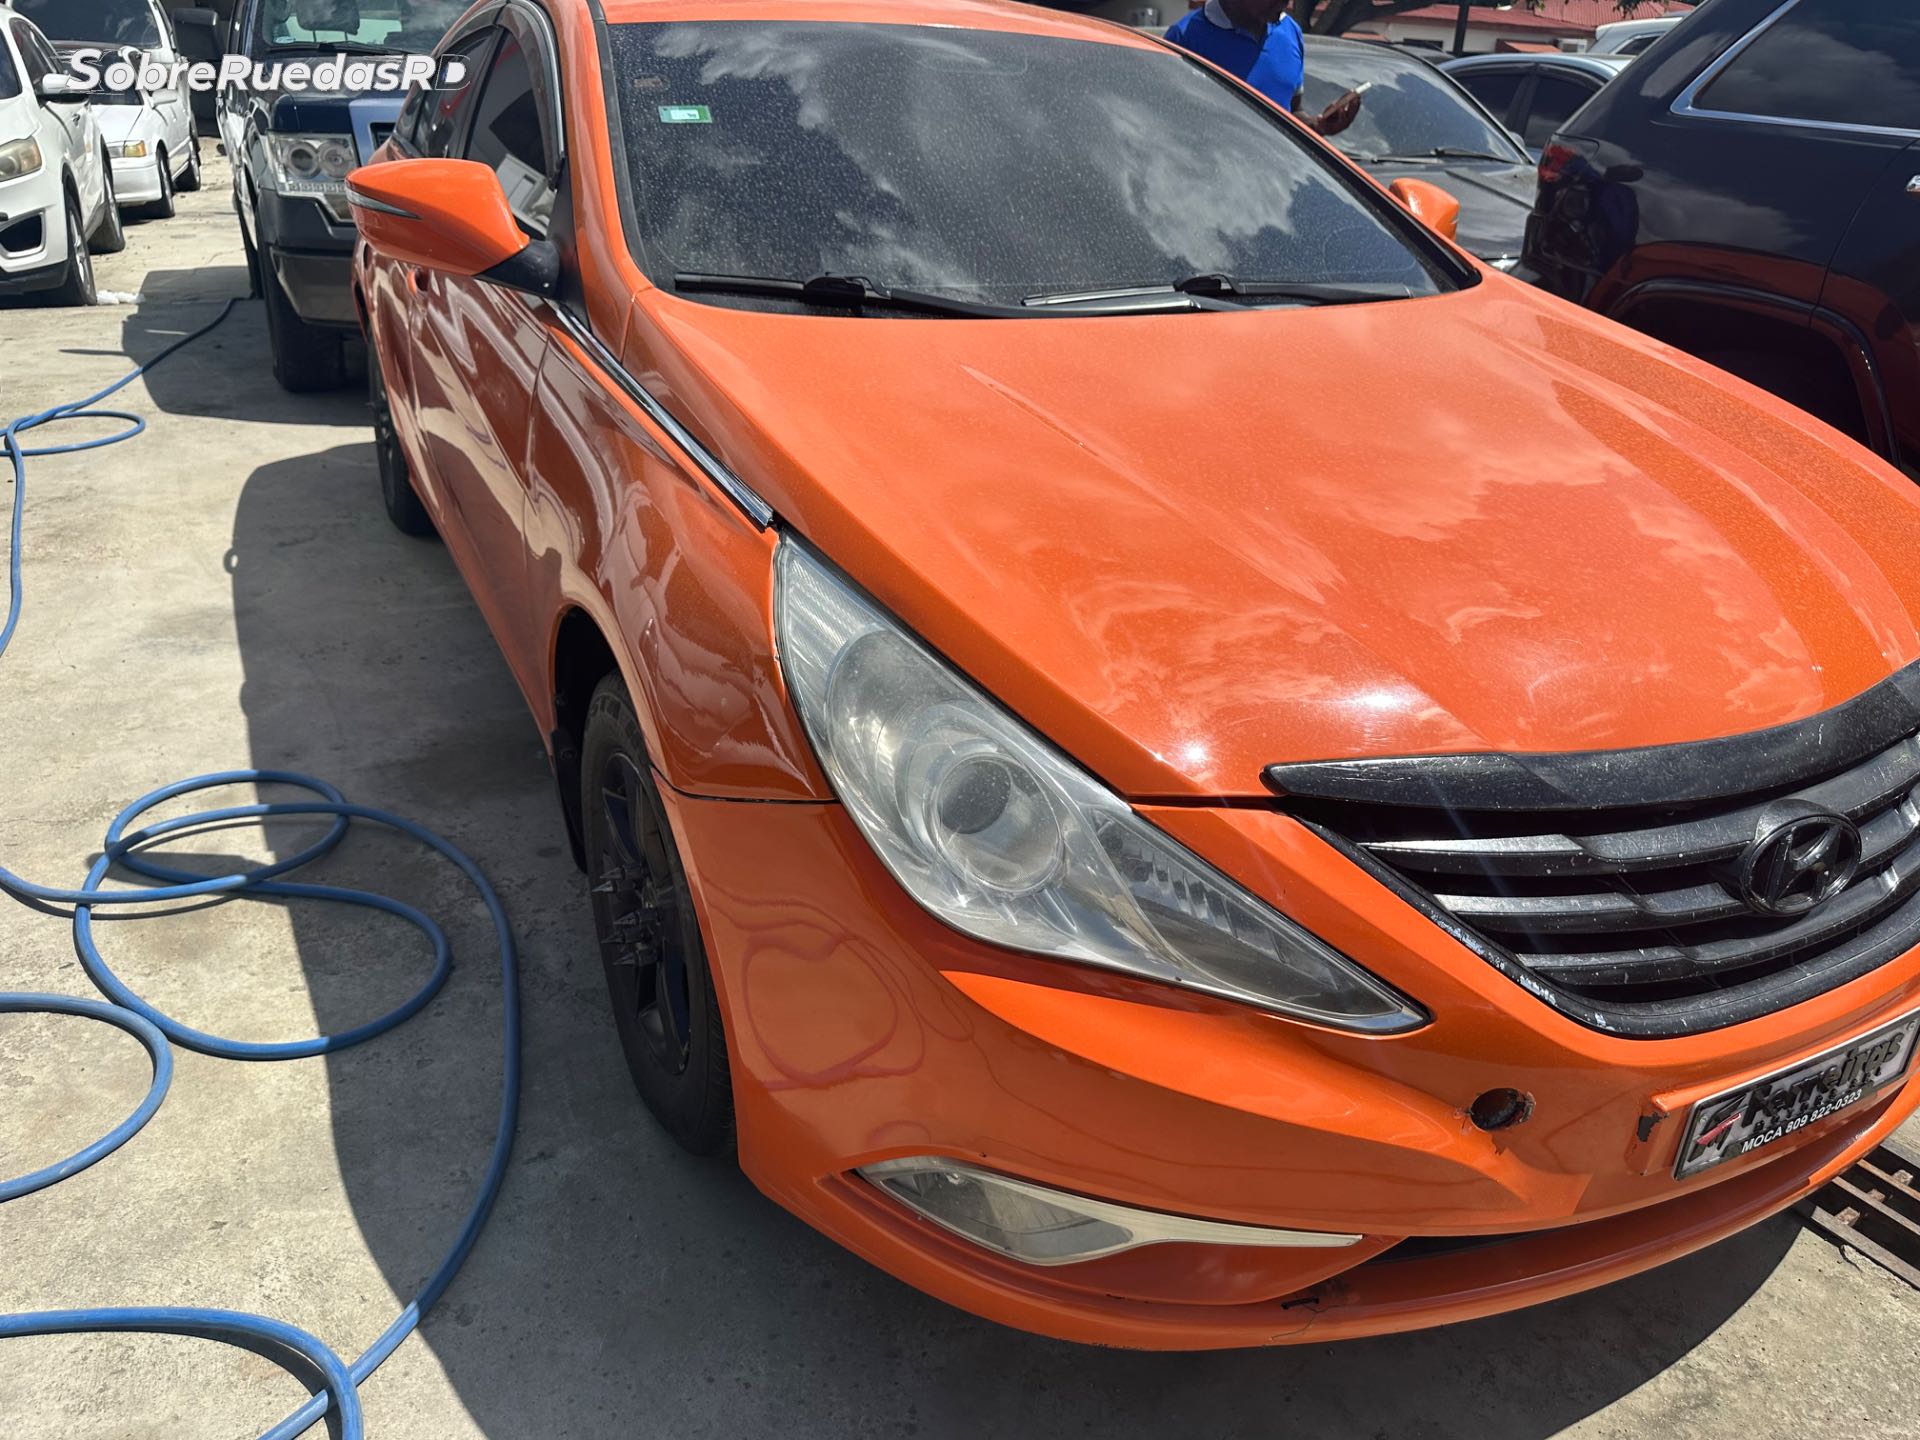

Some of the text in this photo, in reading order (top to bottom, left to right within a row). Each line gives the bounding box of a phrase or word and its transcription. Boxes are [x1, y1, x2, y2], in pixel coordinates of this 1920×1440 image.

[1741, 1088, 1862, 1153] MOCA 809 822-0323
